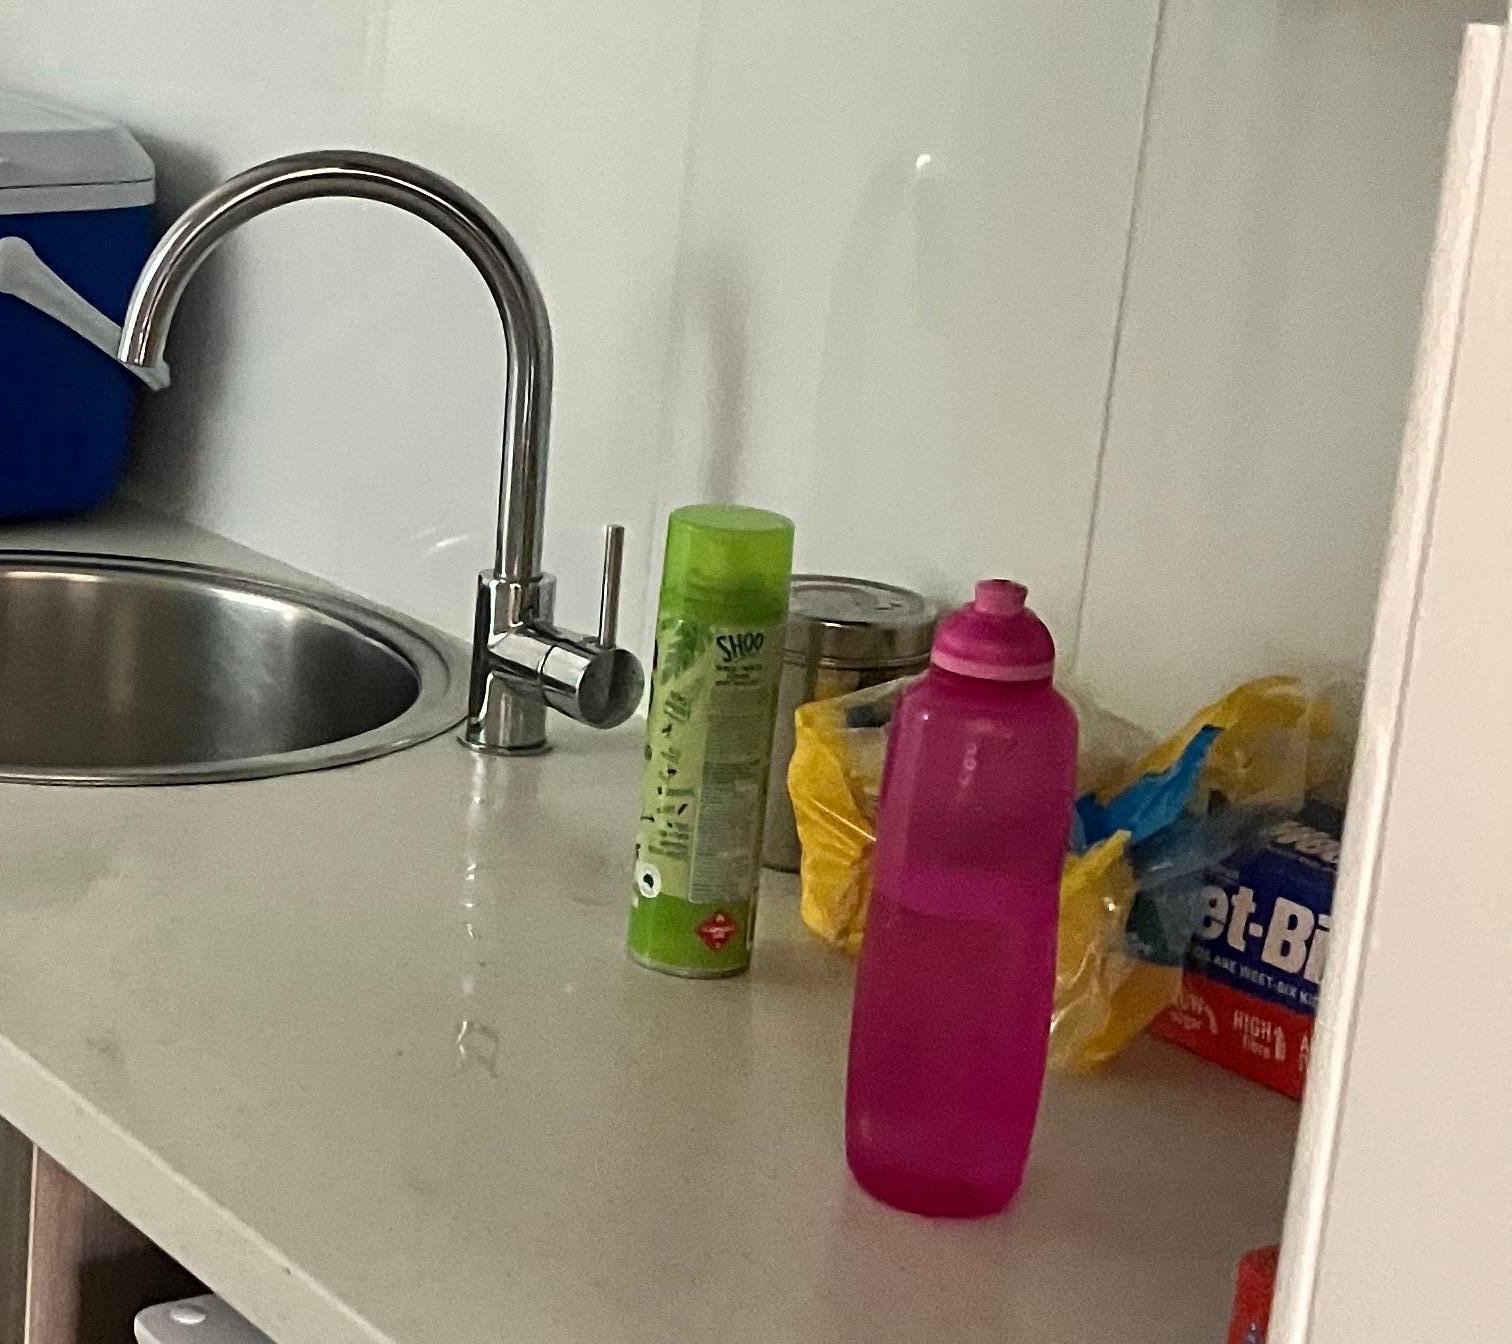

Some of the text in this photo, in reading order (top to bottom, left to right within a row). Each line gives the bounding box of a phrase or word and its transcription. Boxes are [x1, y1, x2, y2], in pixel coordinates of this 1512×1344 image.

[715, 632, 765, 663] SHOO
[1195, 885, 1329, 984] et-Bi
[1233, 1009, 1272, 1043] HIGH
